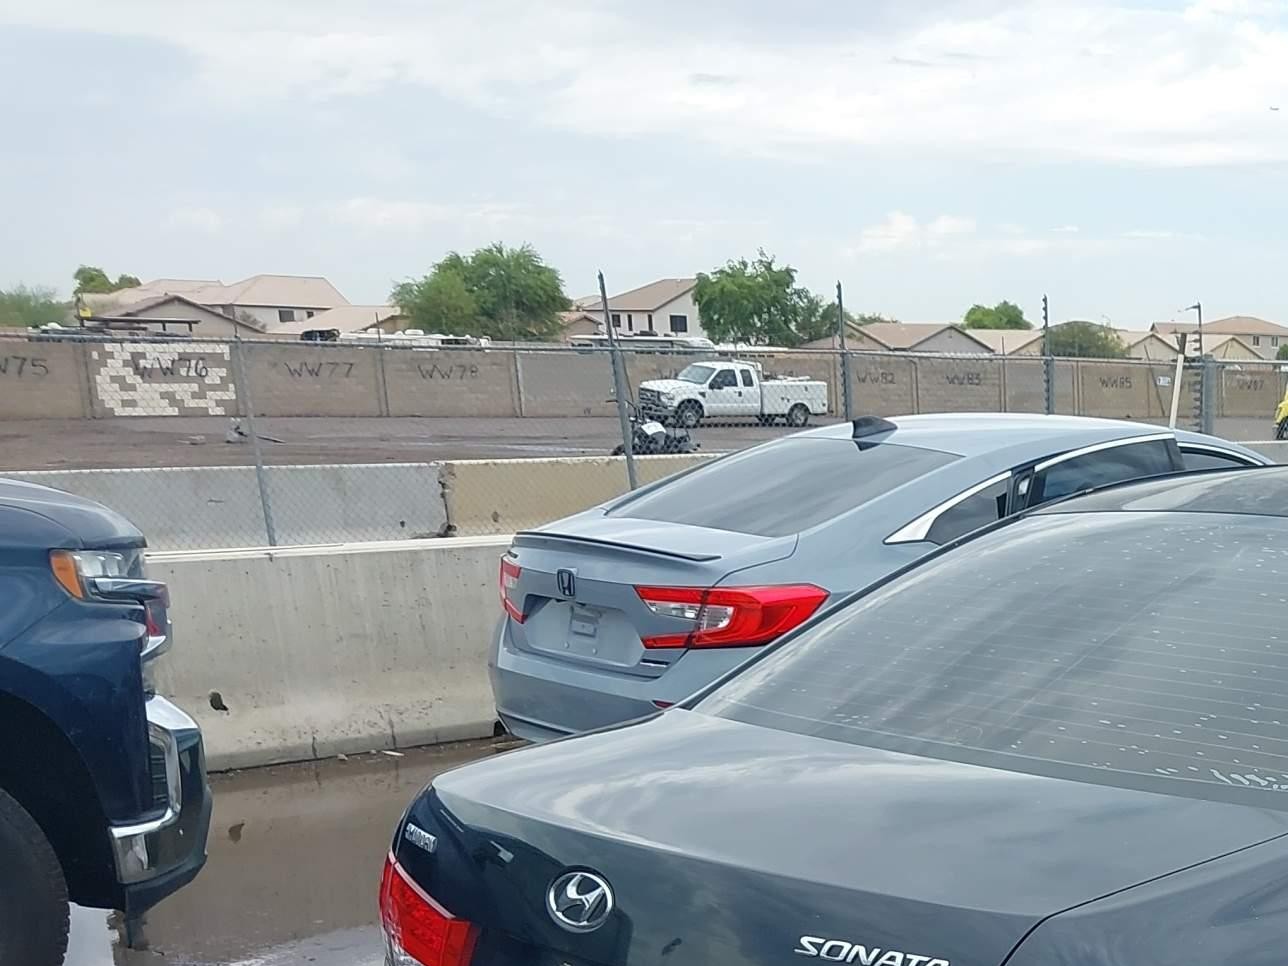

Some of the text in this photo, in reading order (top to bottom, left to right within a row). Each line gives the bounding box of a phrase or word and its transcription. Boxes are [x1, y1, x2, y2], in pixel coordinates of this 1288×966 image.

[133, 356, 209, 379] WW76
[284, 361, 354, 378] WW77
[417, 363, 479, 380] WW78
